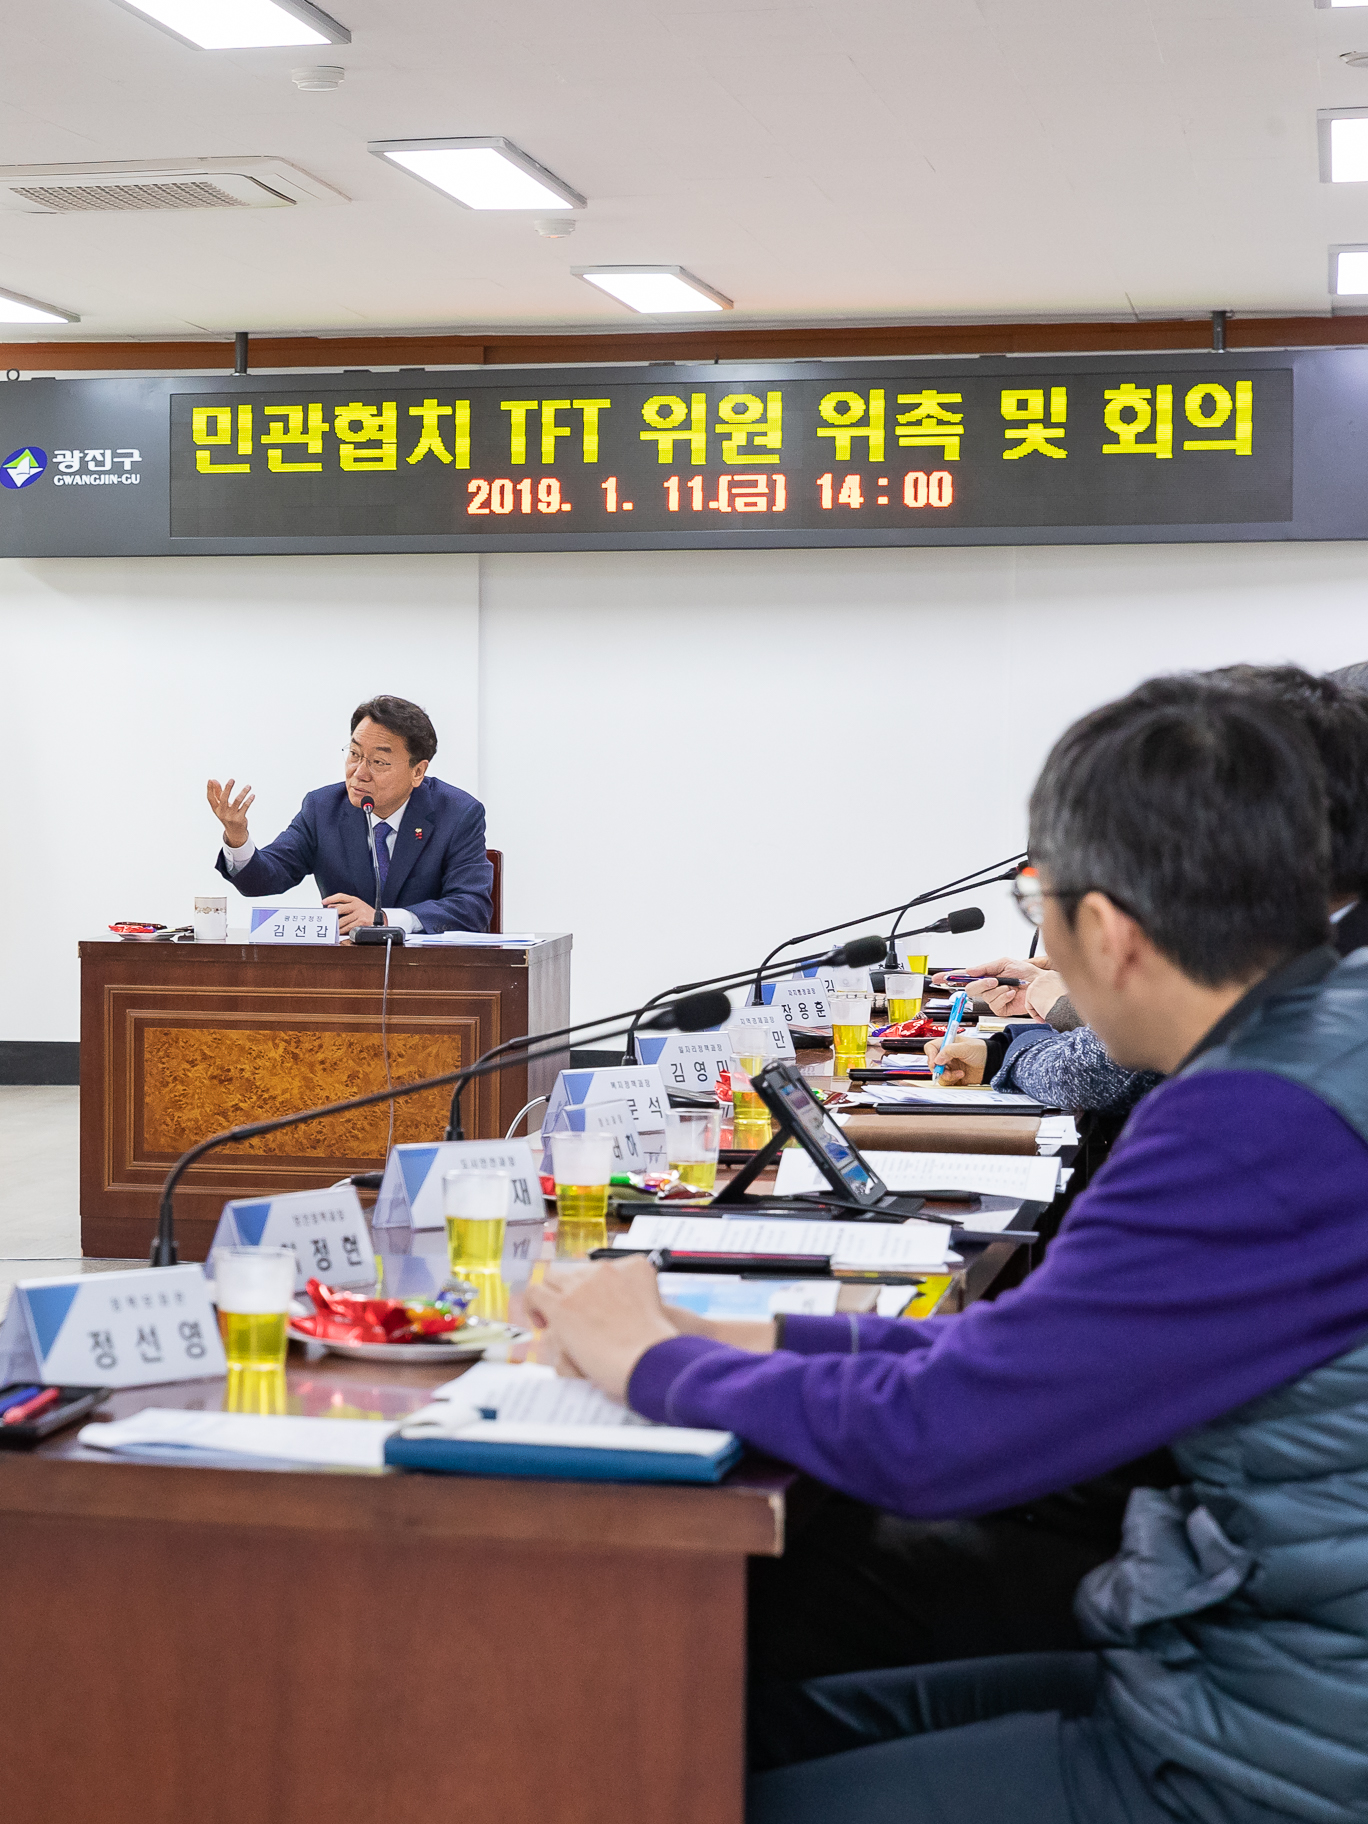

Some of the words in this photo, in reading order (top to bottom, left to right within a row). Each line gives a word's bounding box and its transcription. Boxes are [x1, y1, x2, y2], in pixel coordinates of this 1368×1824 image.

[191, 398, 471, 474] 민관협치
[500, 398, 612, 465] TFT
[639, 391, 783, 466] 위원
[816, 388, 965, 462] 위촉
[1000, 386, 1068, 460] 및
[1101, 380, 1254, 459] 회의
[52, 448, 143, 473] 광진구
[53, 473, 141, 486] GWANGJIN-GU
[466, 477, 572, 515] 2019.
[601, 477, 634, 513] 1.
[273, 924, 329, 938] 김선갑
[781, 1001, 827, 1022] 장용훈
[88, 1319, 207, 1370] 정선영
